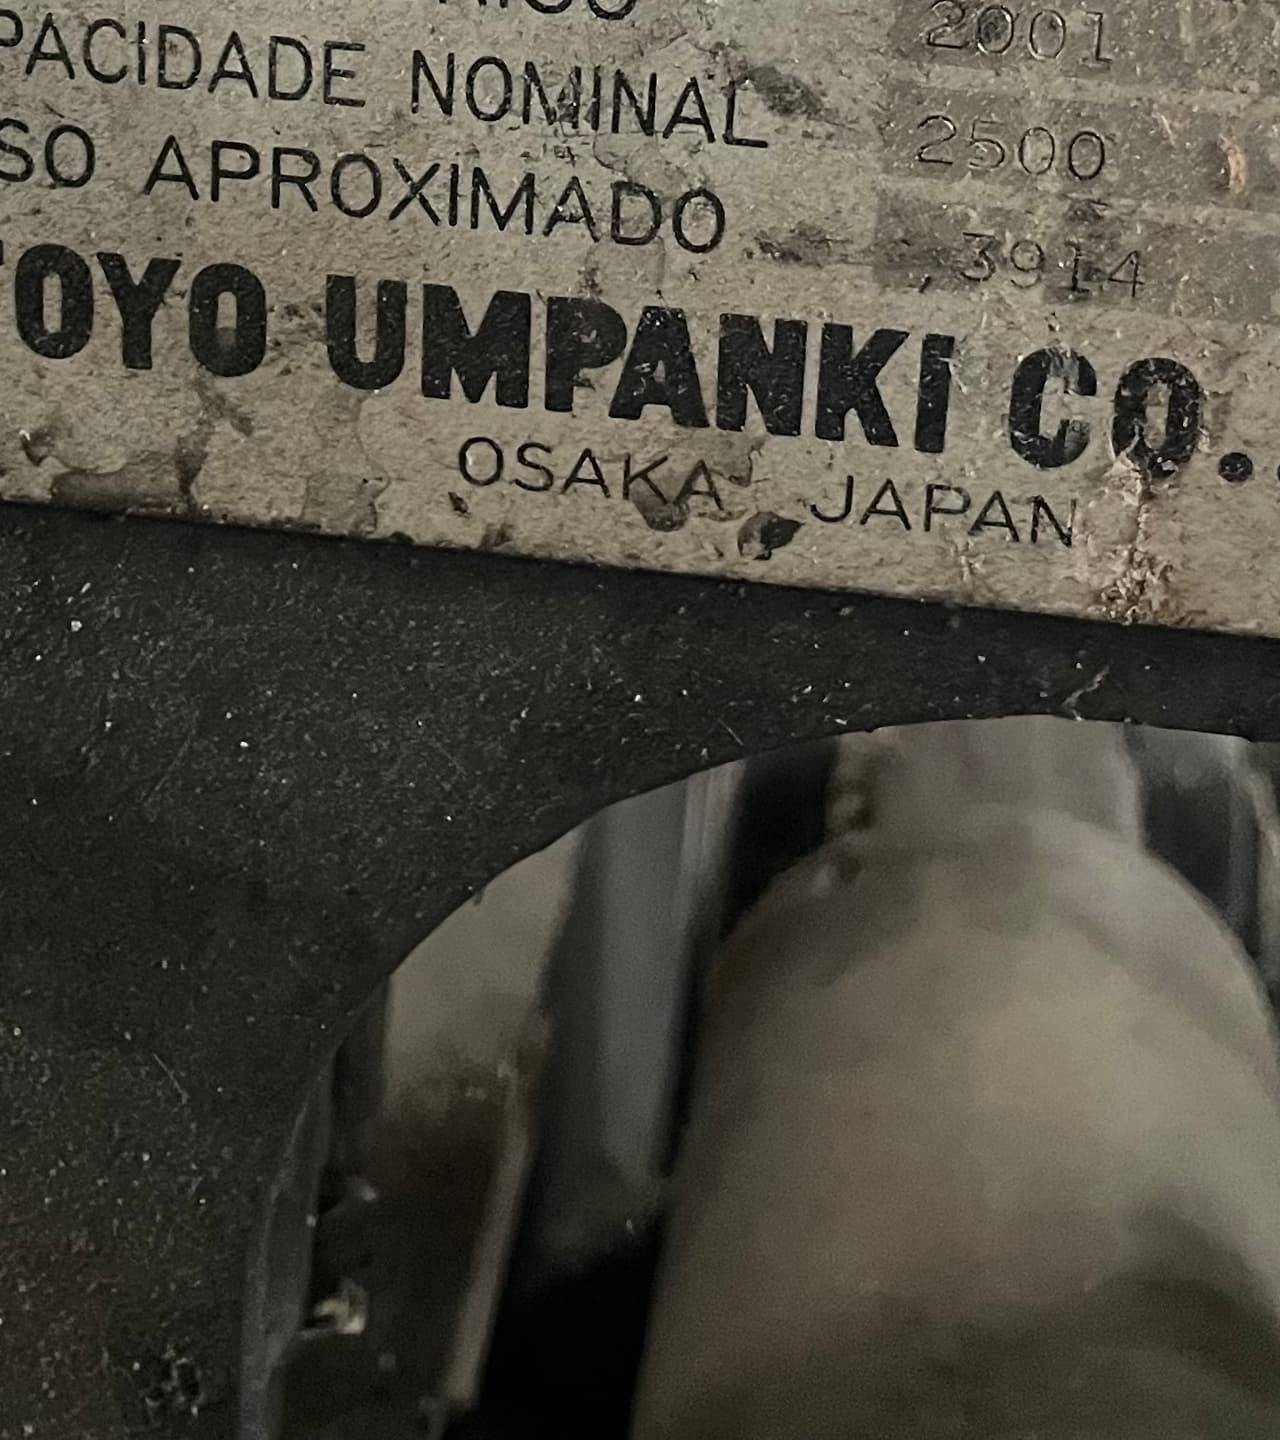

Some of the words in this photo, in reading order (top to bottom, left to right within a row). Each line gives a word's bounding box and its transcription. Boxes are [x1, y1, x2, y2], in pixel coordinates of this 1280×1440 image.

[410, 50, 771, 149] NOMINAL
[915, 113, 1108, 182] 2500
[143, 135, 727, 255] APROXIMADO
[959, 231, 1145, 299] 3914
[326, 274, 955, 453] UMPANKI
[457, 435, 723, 510] OSAKA
[809, 474, 1075, 549] JAPAN
